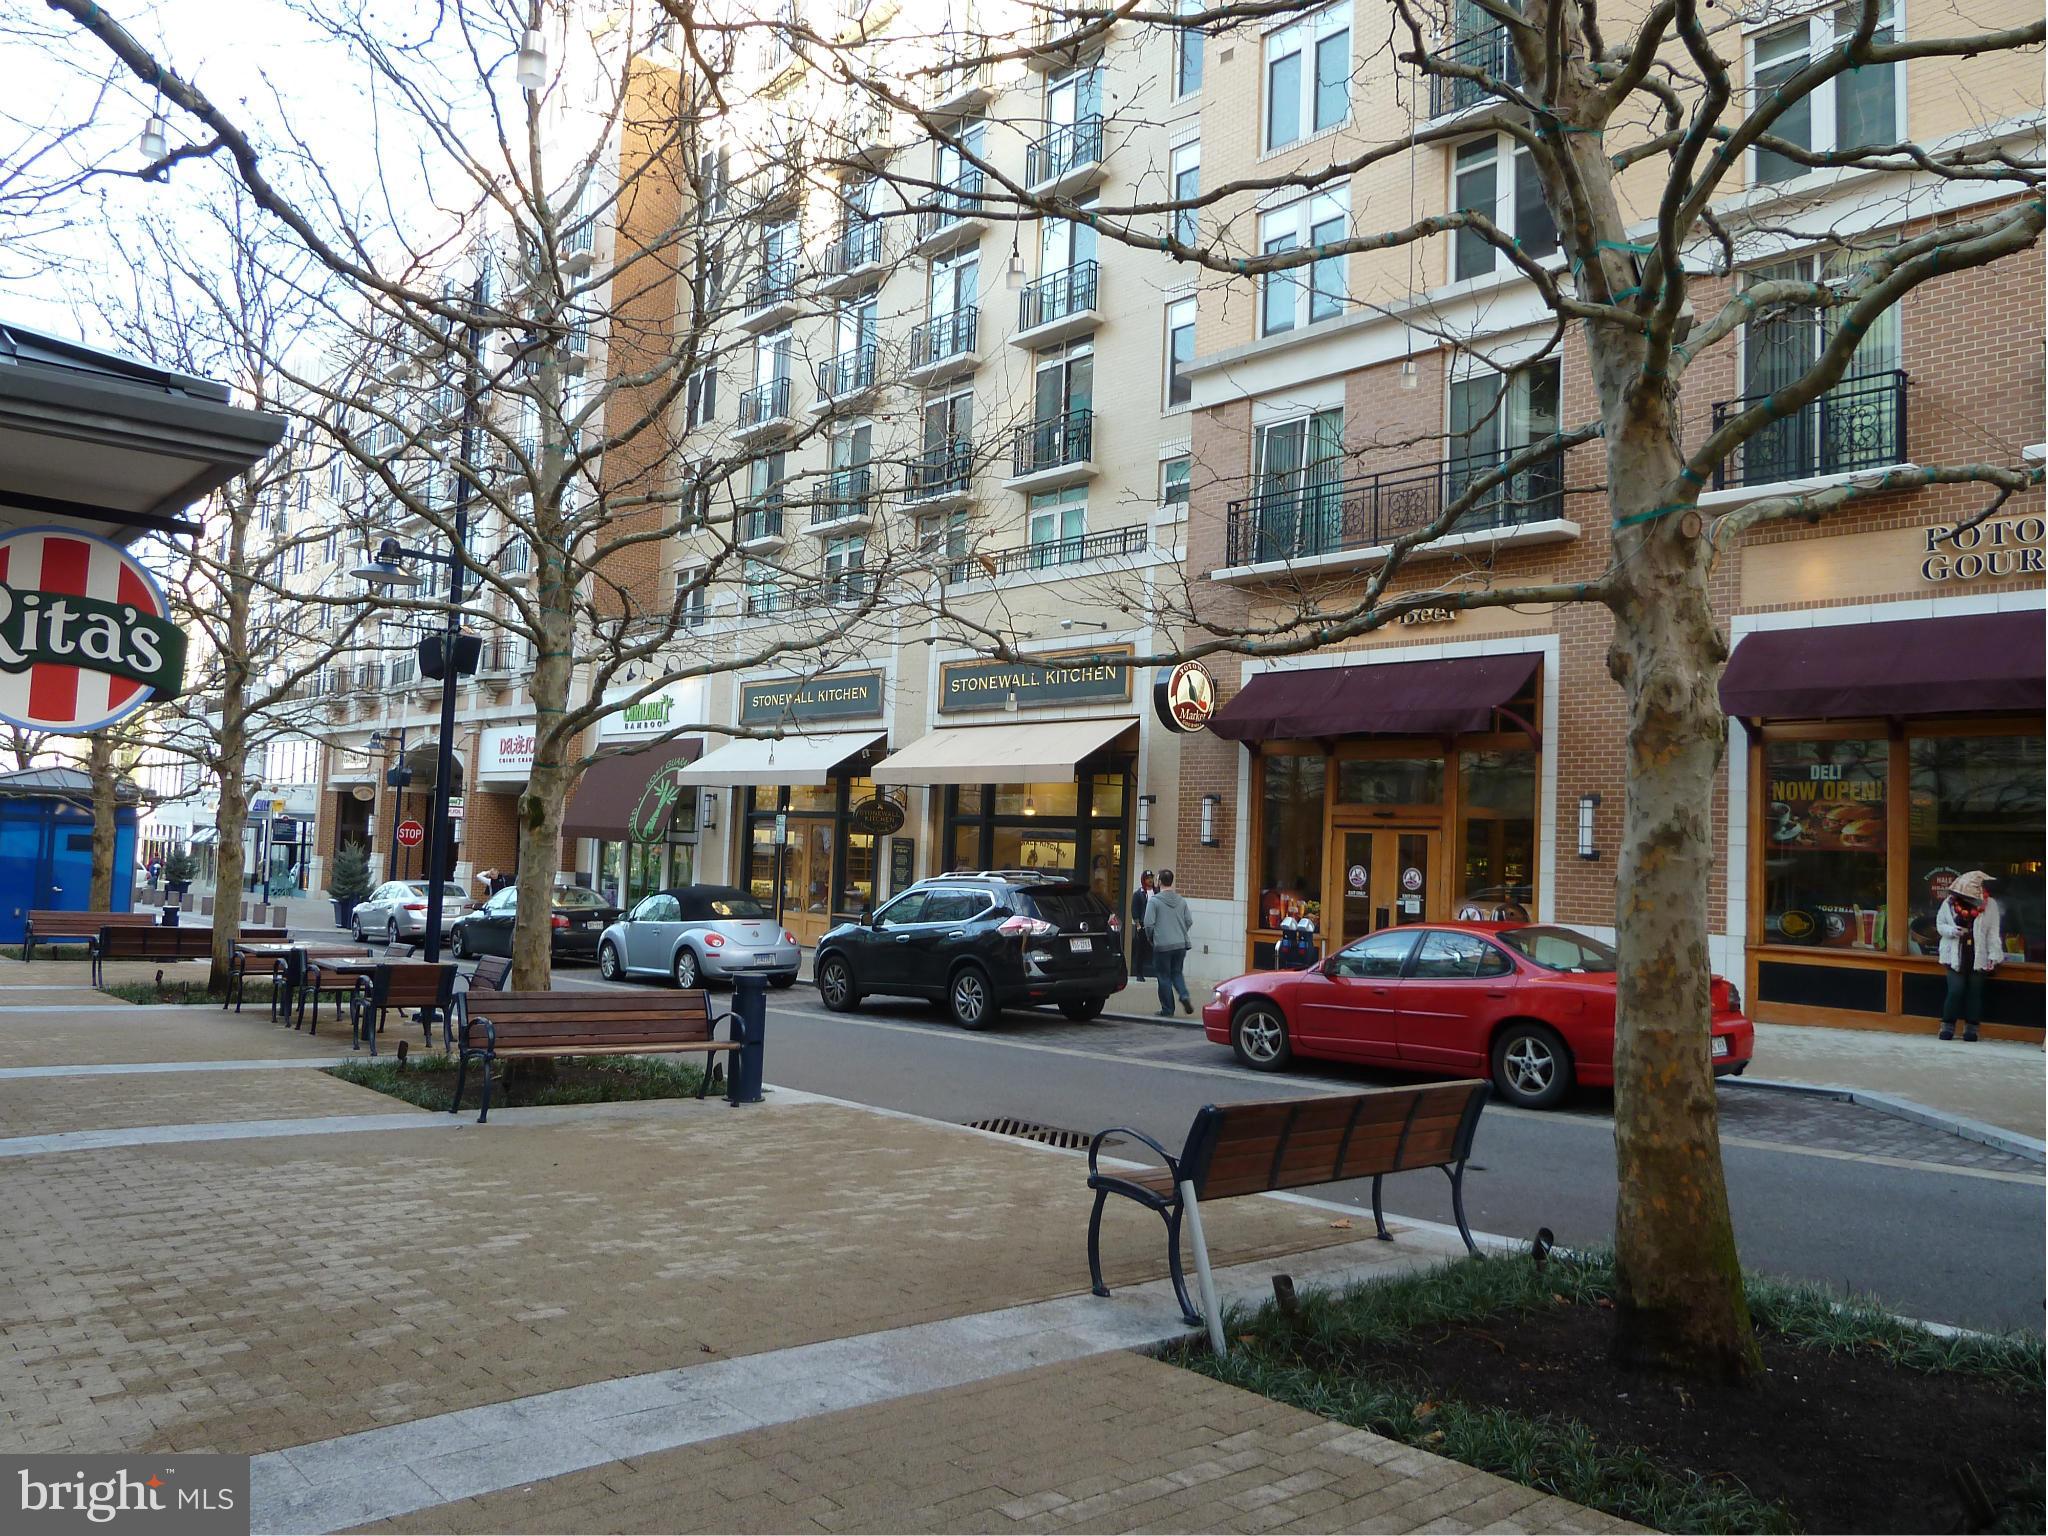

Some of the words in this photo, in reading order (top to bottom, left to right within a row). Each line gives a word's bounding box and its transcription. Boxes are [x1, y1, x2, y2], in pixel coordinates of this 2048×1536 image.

[1923, 517, 2046, 553] POTO
[1921, 547, 2046, 581] GOUR
[951, 671, 1040, 693] STONEWALL
[1045, 665, 1117, 685] KITCHEN
[752, 691, 815, 707] STONEWALL
[817, 686, 868, 702] KITCHEN
[624, 720, 663, 730] BAMBOO
[1810, 764, 1842, 780] DELI
[1772, 781, 1818, 801] NOW
[1823, 780, 1883, 801] OPEN!
[399, 828, 422, 839] STOP
